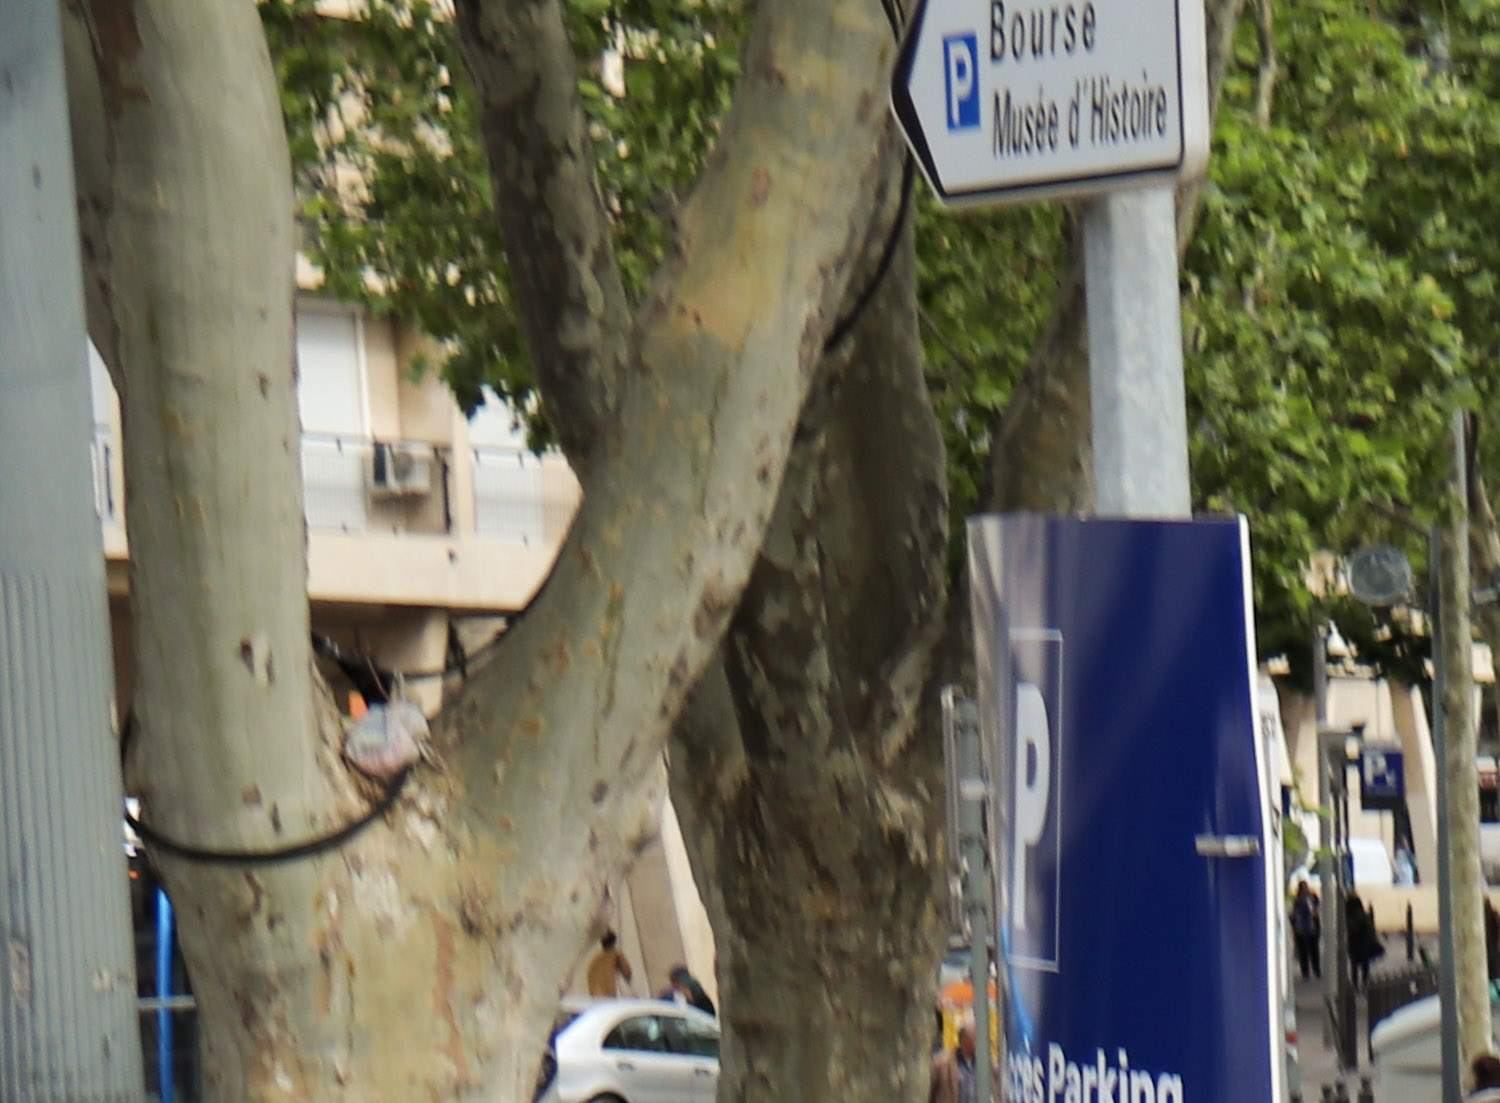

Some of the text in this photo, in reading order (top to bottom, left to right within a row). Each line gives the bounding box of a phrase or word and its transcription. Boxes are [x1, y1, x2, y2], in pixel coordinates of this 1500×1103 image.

[990, 0, 1097, 64] Bourse
[949, 40, 973, 128] P
[992, 68, 1168, 160] Musée d'Histoire
[1013, 682, 1050, 930] P
